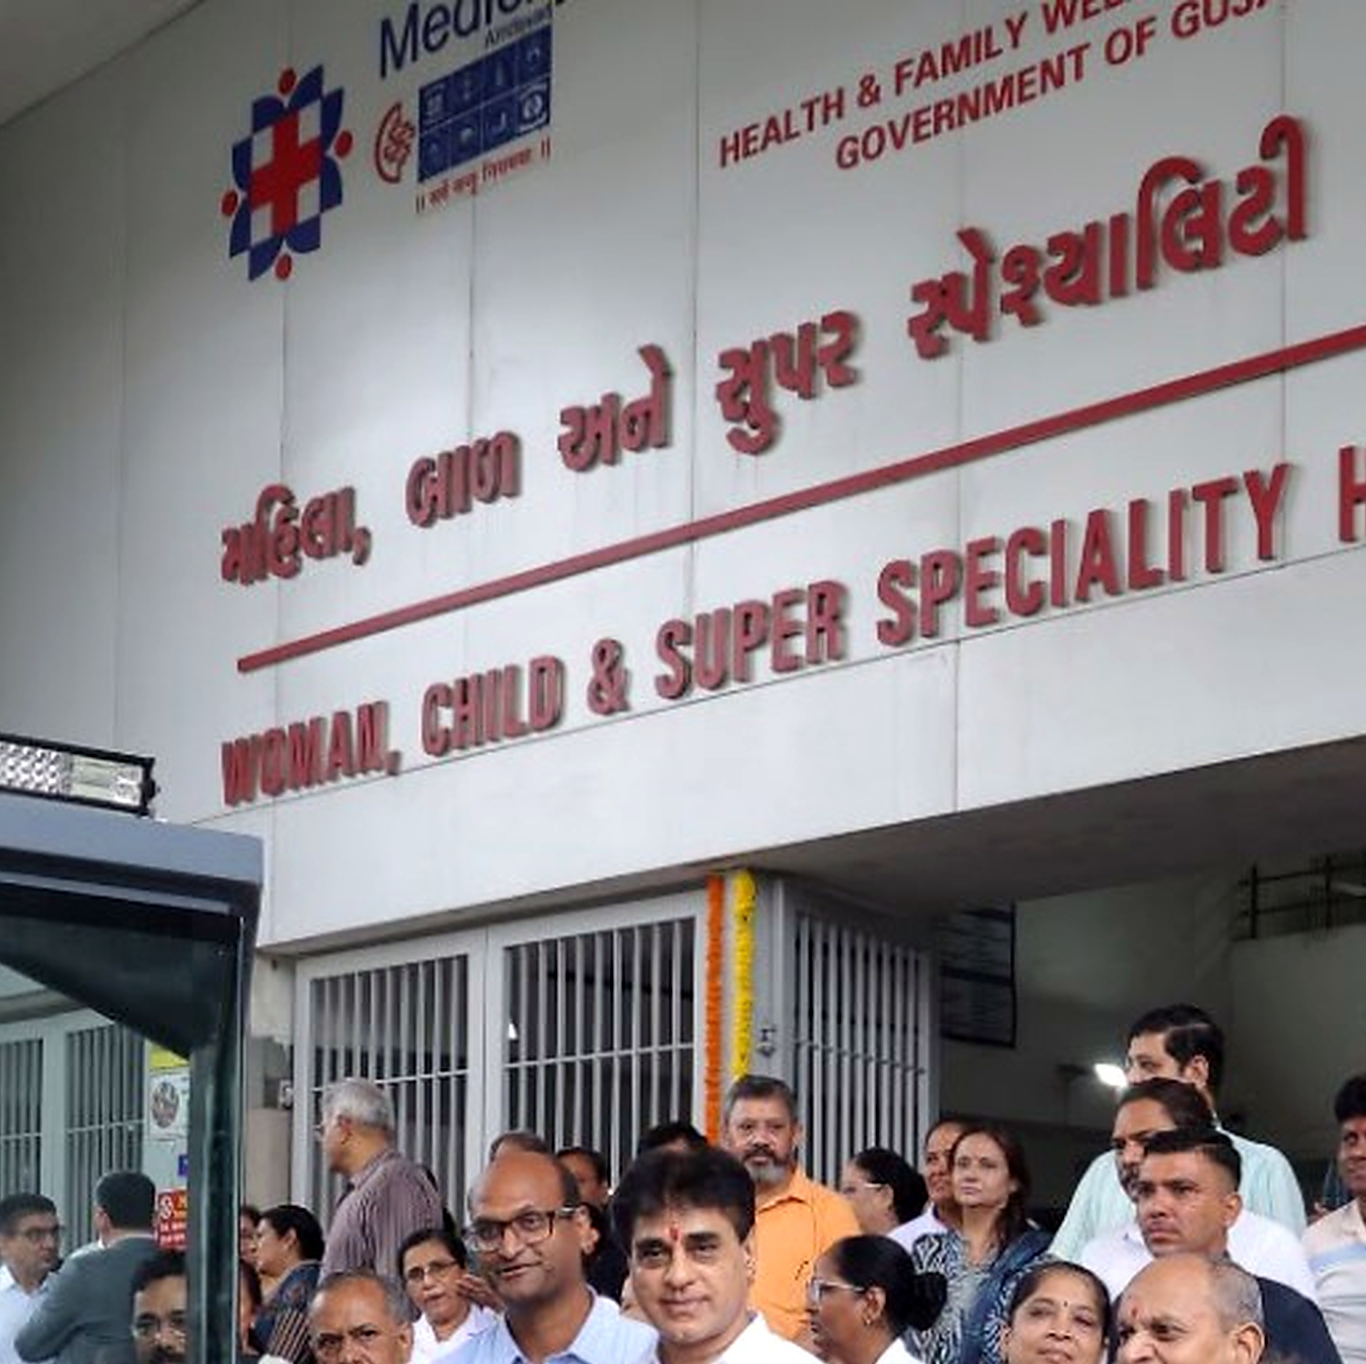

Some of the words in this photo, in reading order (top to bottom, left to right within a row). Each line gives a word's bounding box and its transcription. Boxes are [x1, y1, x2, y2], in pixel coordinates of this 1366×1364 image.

[719, 88, 845, 167] HEALTH
[857, 73, 882, 107] &
[894, 13, 1028, 96] FAMILY
[837, 43, 1091, 170] GOVERNMENT
[1104, 16, 1157, 66] OF
[406, 431, 518, 527] બાળ
[559, 344, 670, 471] અને
[716, 311, 858, 454] સુપર
[222, 701, 401, 806] WOMAN,
[422, 655, 563, 757] CHILD
[587, 638, 629, 716] &
[655, 580, 849, 700] SUPER
[876, 462, 1293, 647] SPECIALITY
